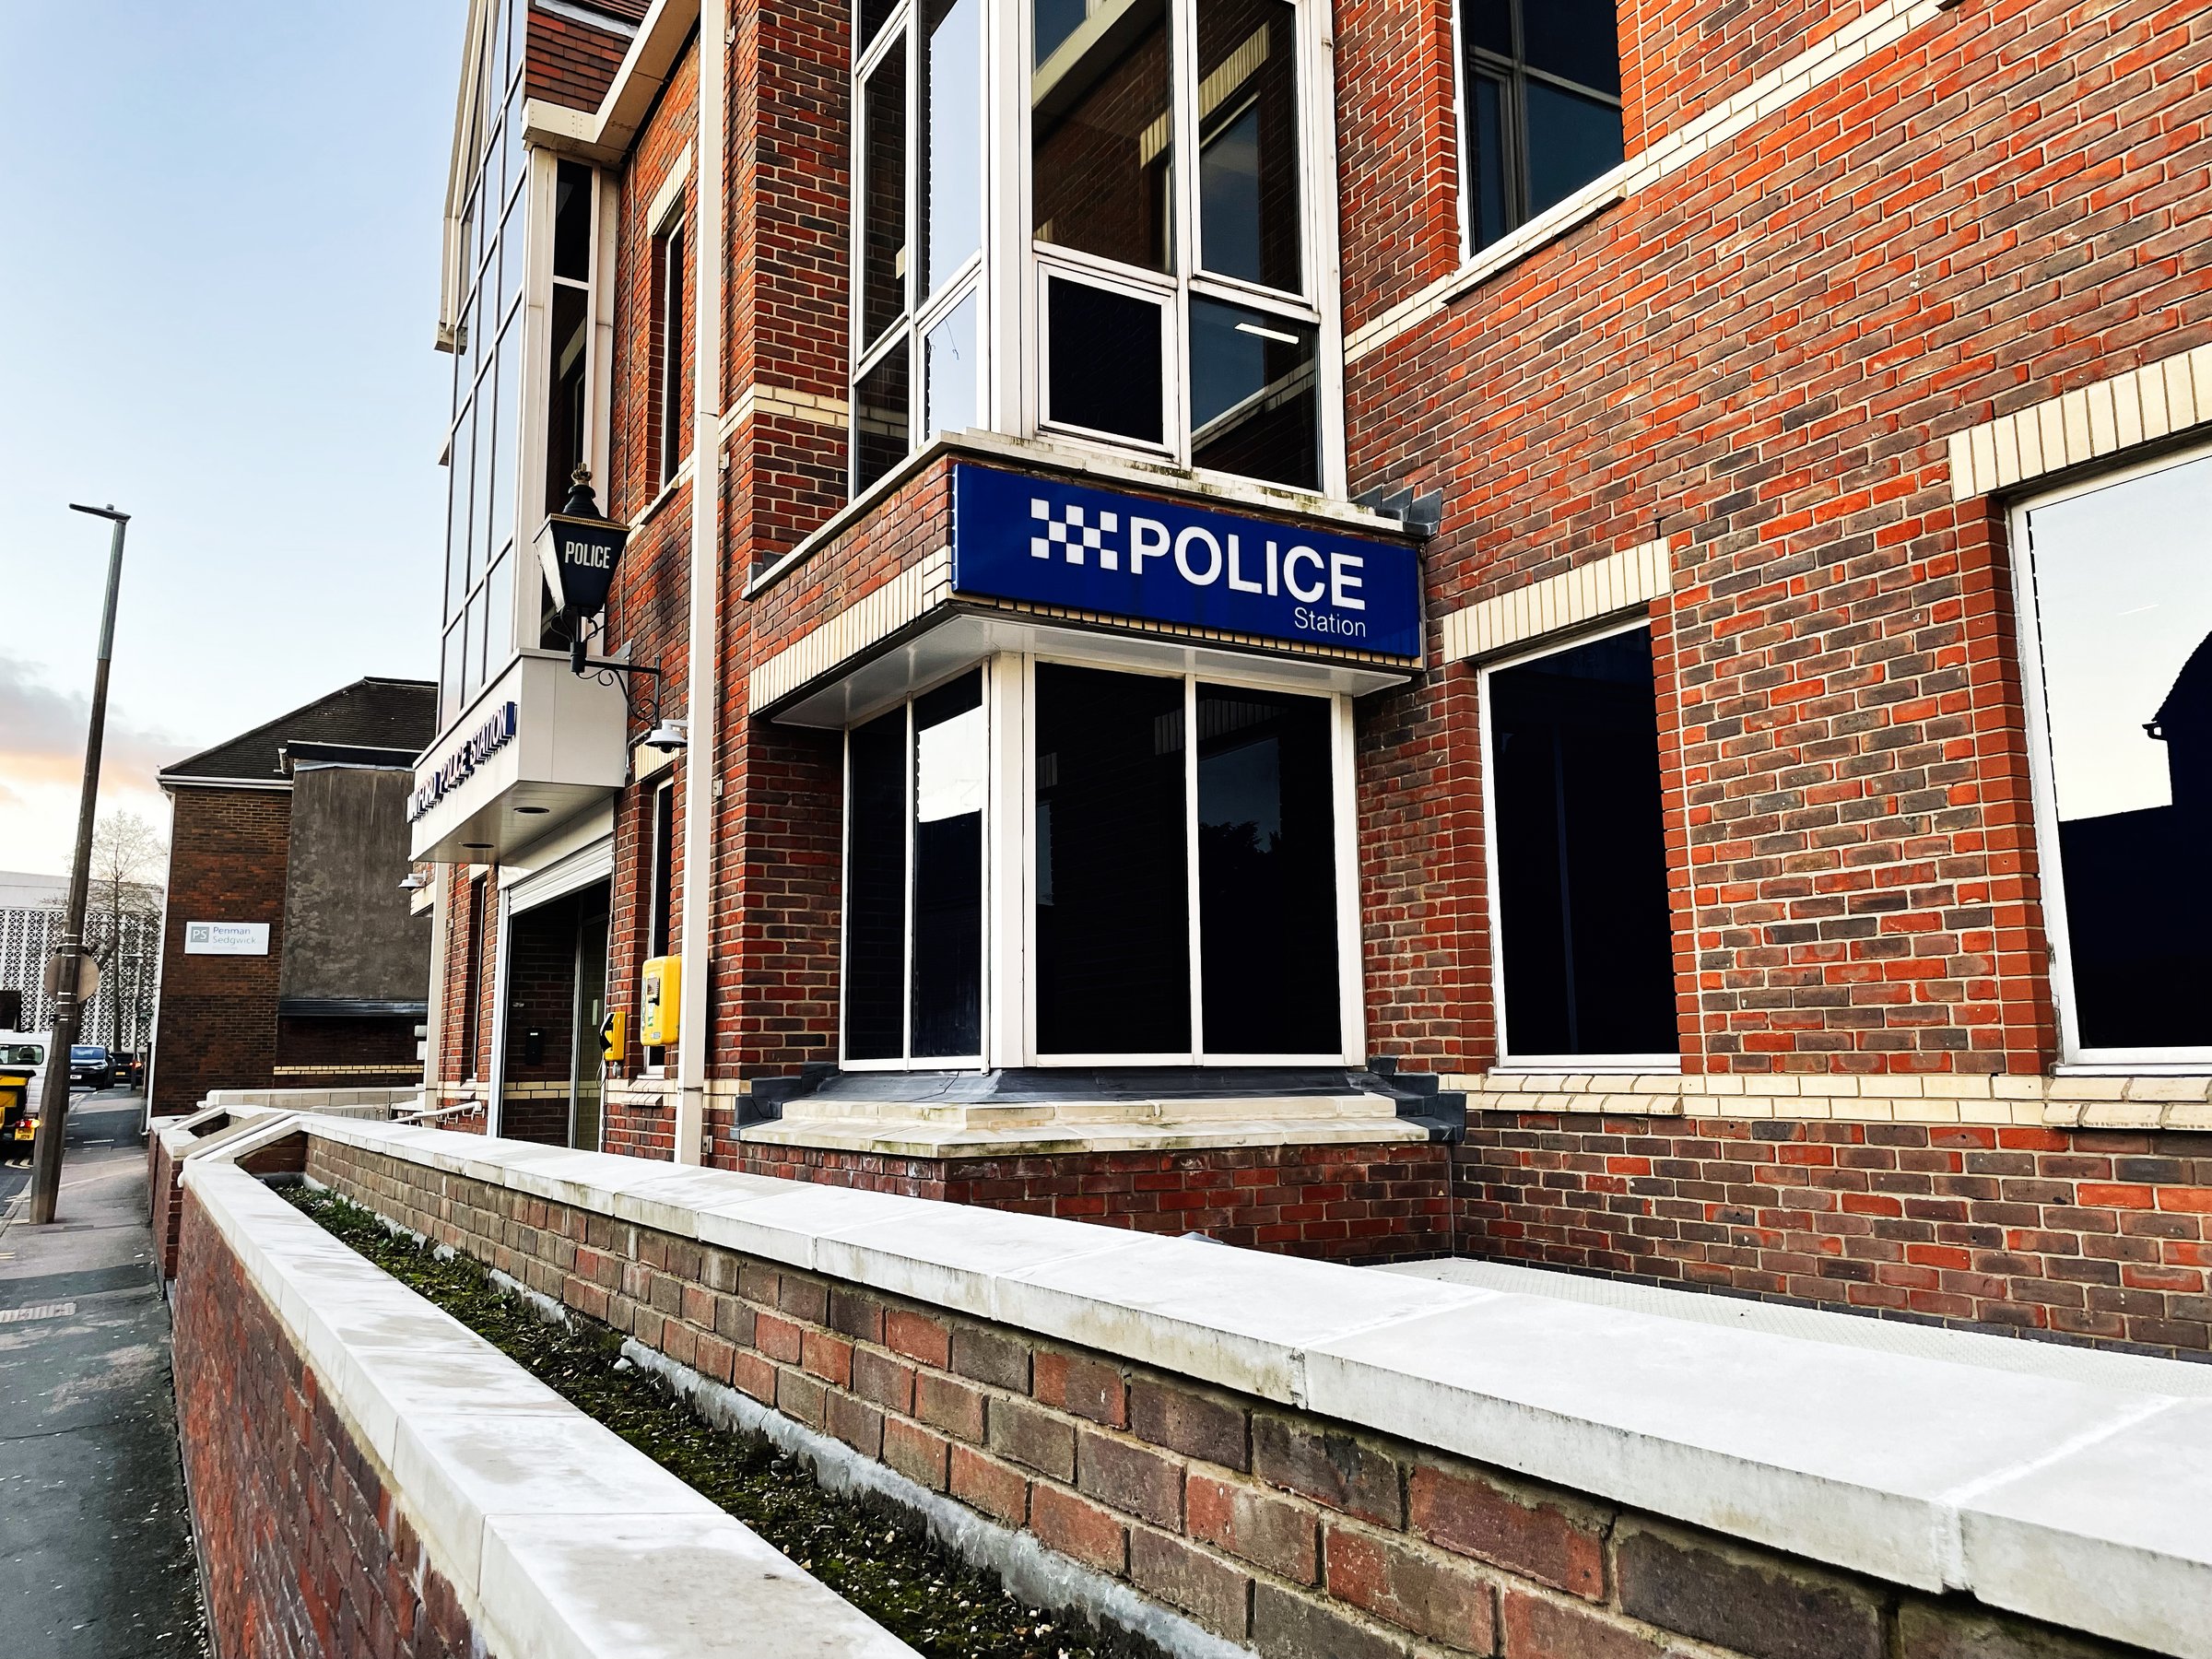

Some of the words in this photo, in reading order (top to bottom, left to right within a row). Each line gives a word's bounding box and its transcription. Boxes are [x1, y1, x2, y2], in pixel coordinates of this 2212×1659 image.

[564, 540, 611, 570] POLICE
[1130, 516, 1366, 610] POLICE
[1293, 606, 1366, 638] Station
[440, 740, 473, 794] POLICE
[469, 701, 515, 766] STATION
[192, 929, 208, 940] PS
[213, 926, 251, 935] Penman
[213, 935, 256, 946] Sedgwick
